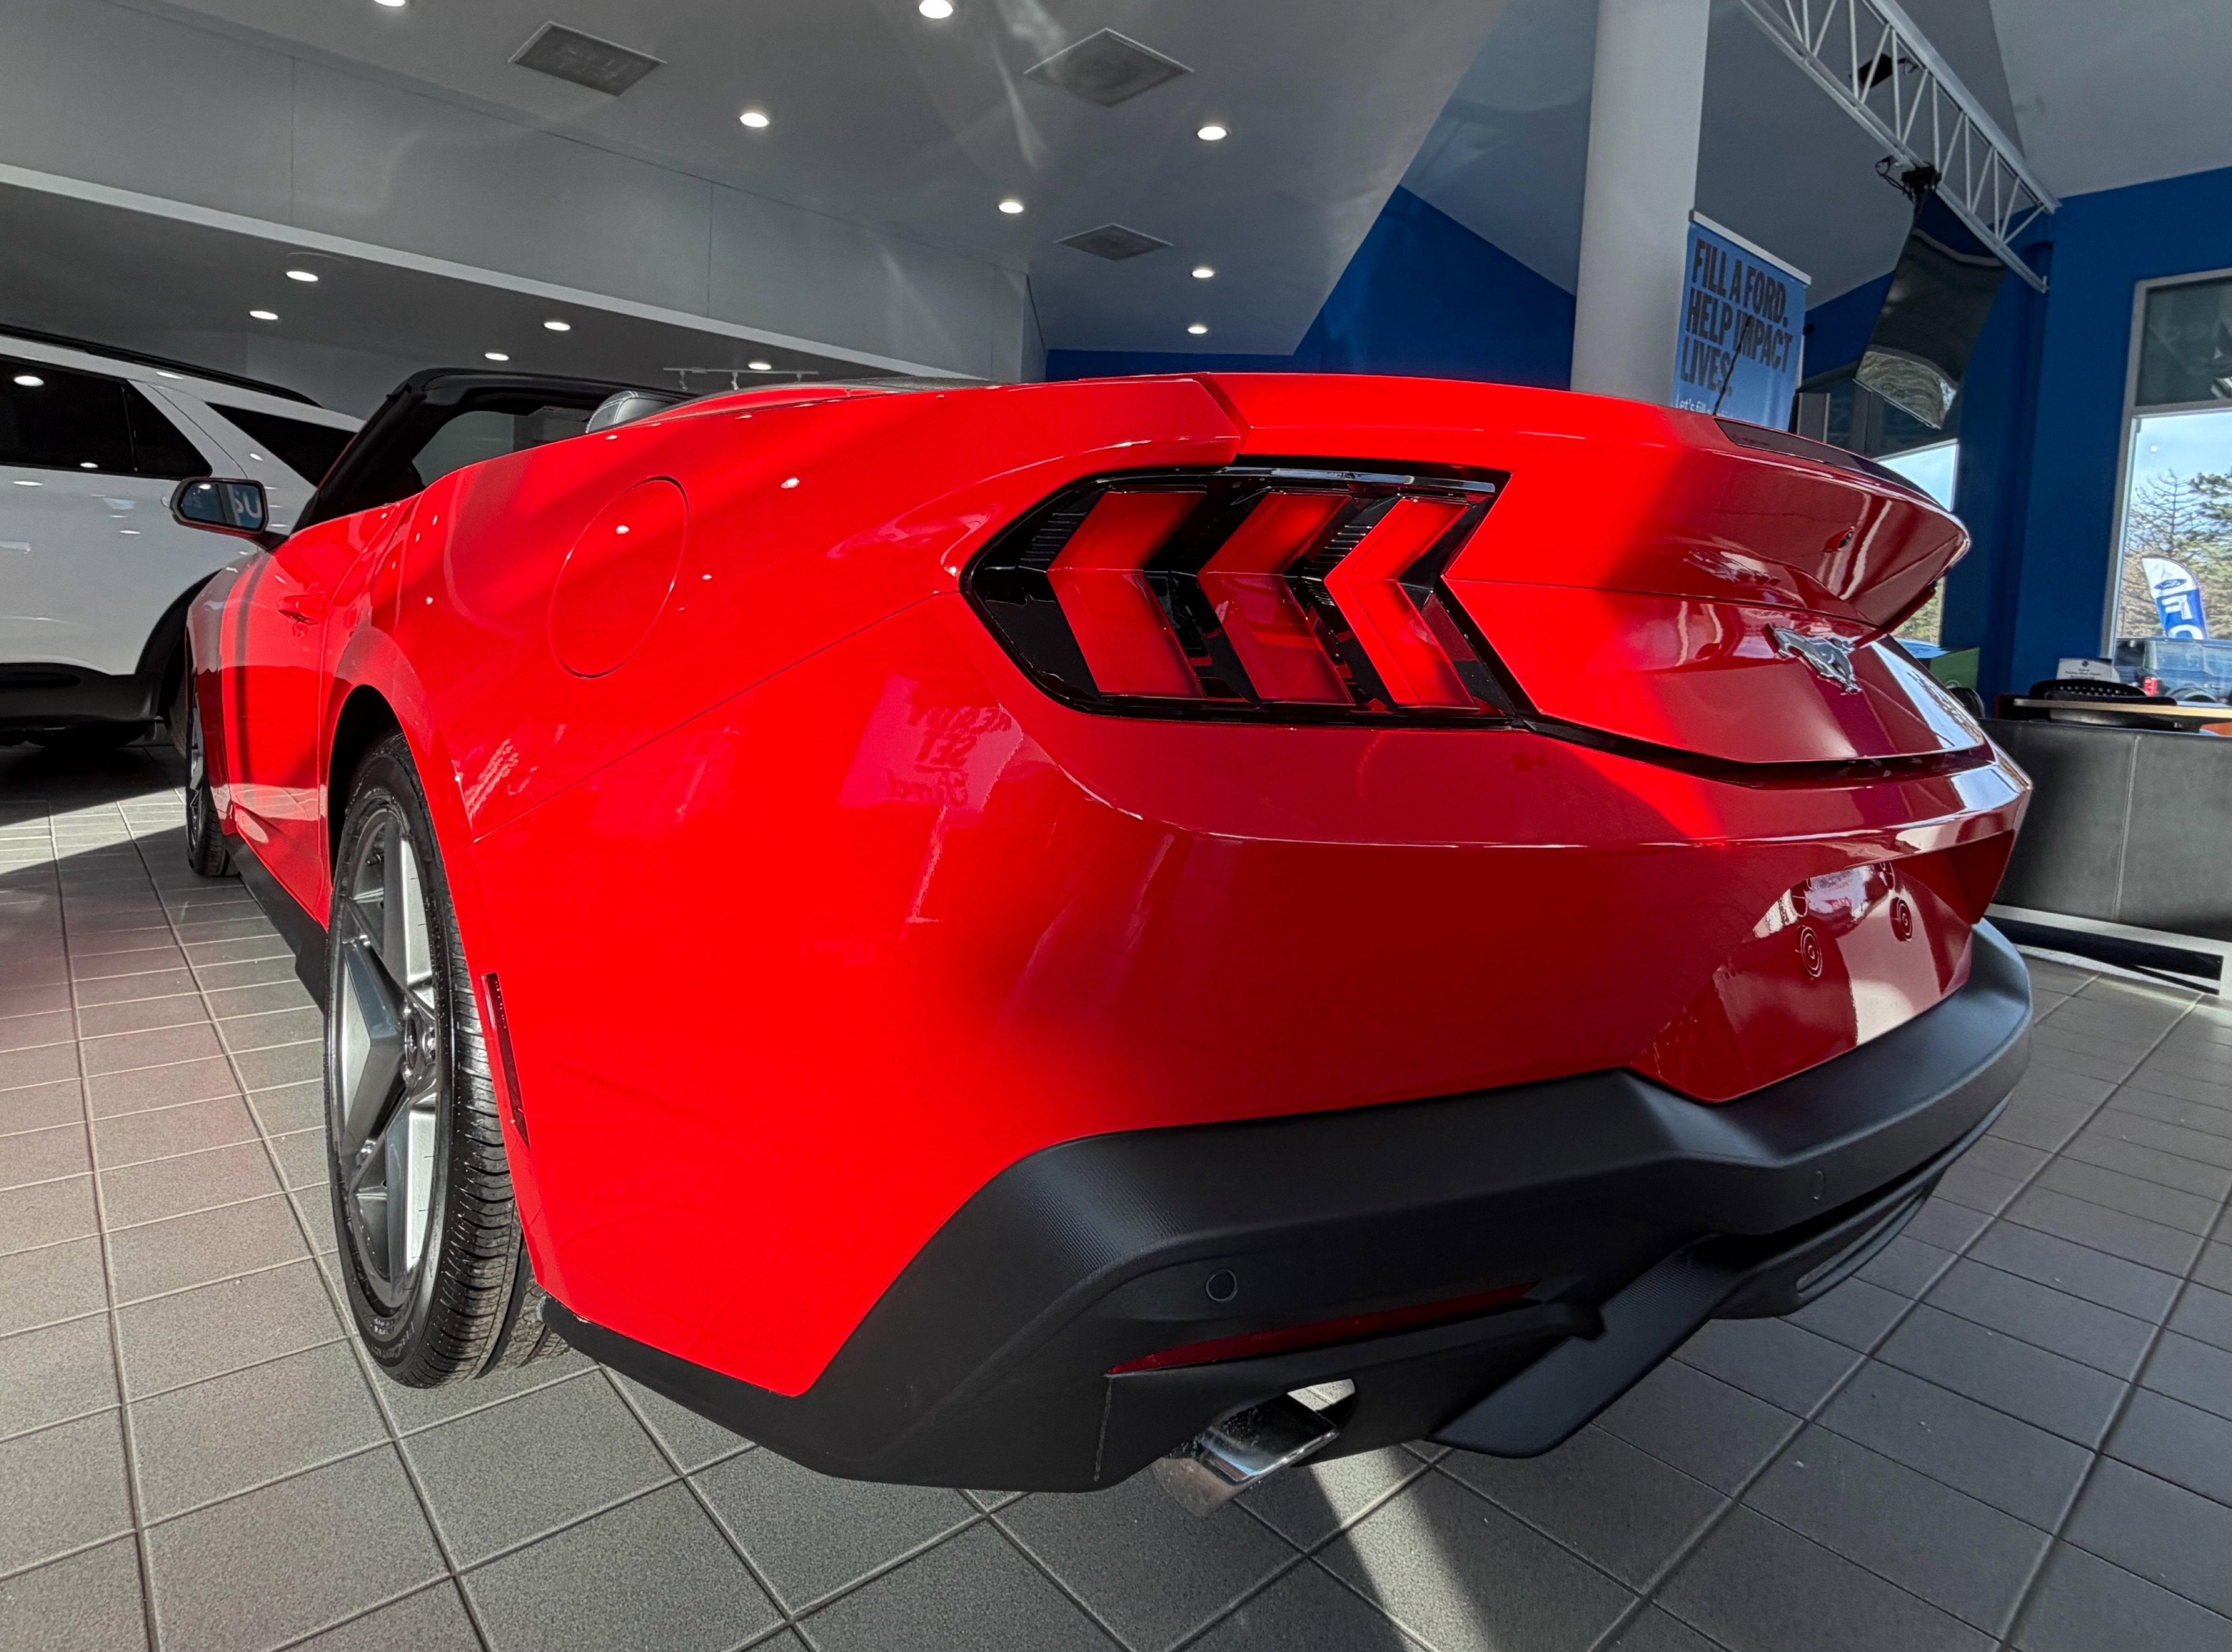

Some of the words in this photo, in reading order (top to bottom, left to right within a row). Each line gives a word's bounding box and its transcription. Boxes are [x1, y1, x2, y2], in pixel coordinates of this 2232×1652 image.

[1692, 239, 1727, 297] FILL
[1729, 258, 1742, 305] A
[1744, 266, 1788, 327] FORD.
[1680, 336, 1733, 397] LIVES.
[1686, 287, 1733, 345] HELP
[1734, 309, 1793, 373] IMPACT
